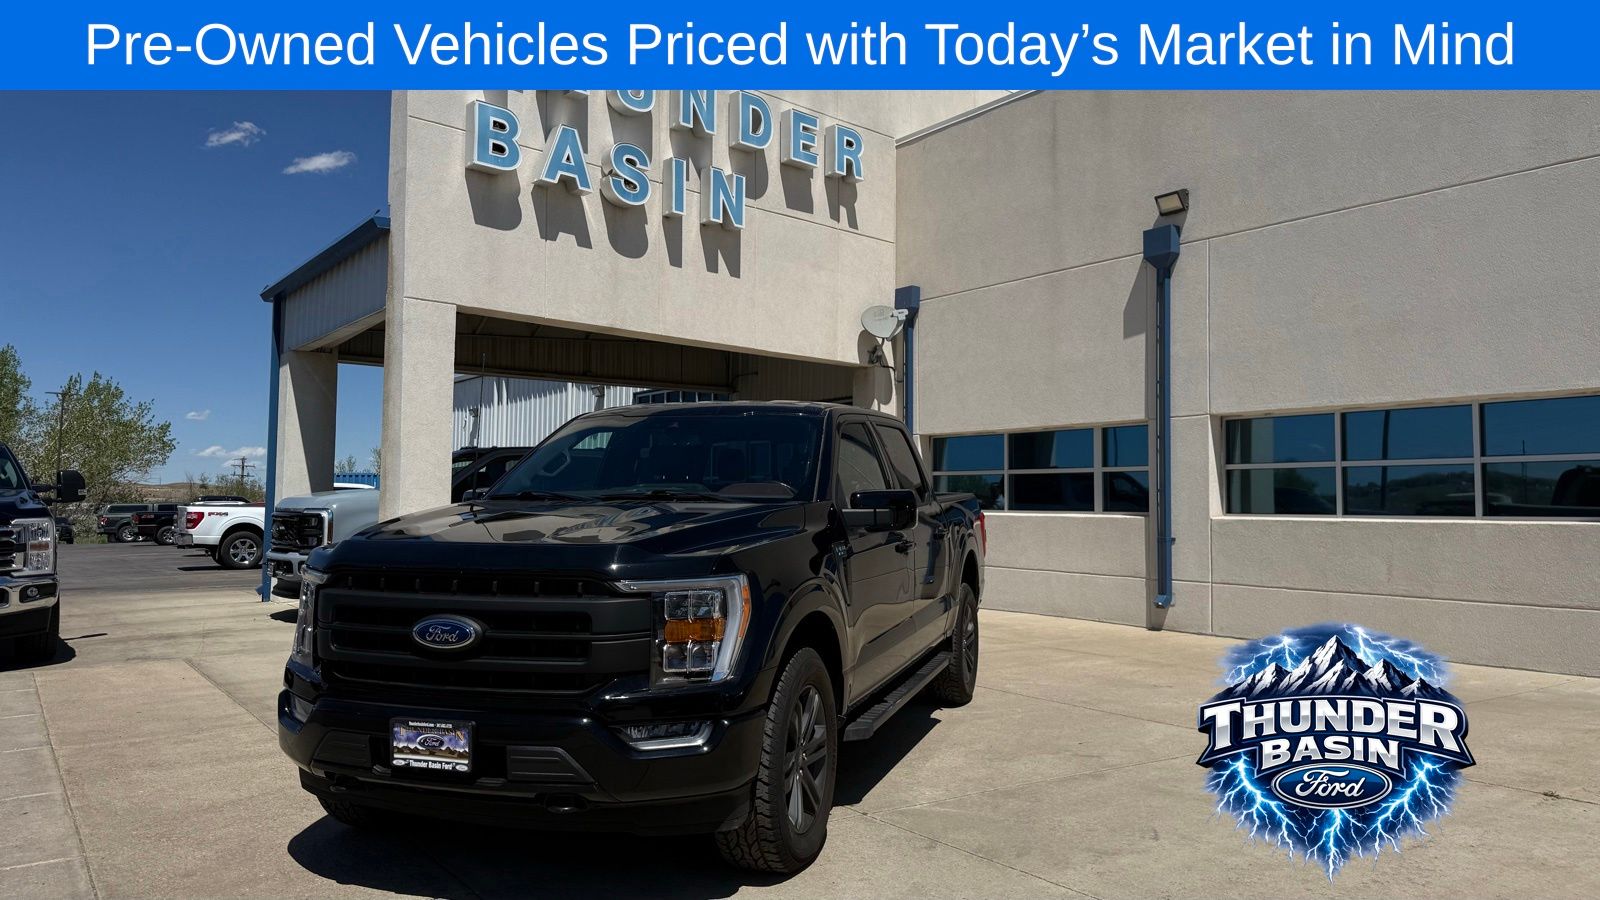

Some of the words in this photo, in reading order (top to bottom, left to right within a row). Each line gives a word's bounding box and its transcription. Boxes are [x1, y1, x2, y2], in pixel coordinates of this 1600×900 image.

[466, 100, 746, 230] BASIN
[426, 625, 459, 642] Ford
[424, 736, 441, 747] Ford
[428, 761, 442, 769] Basin
